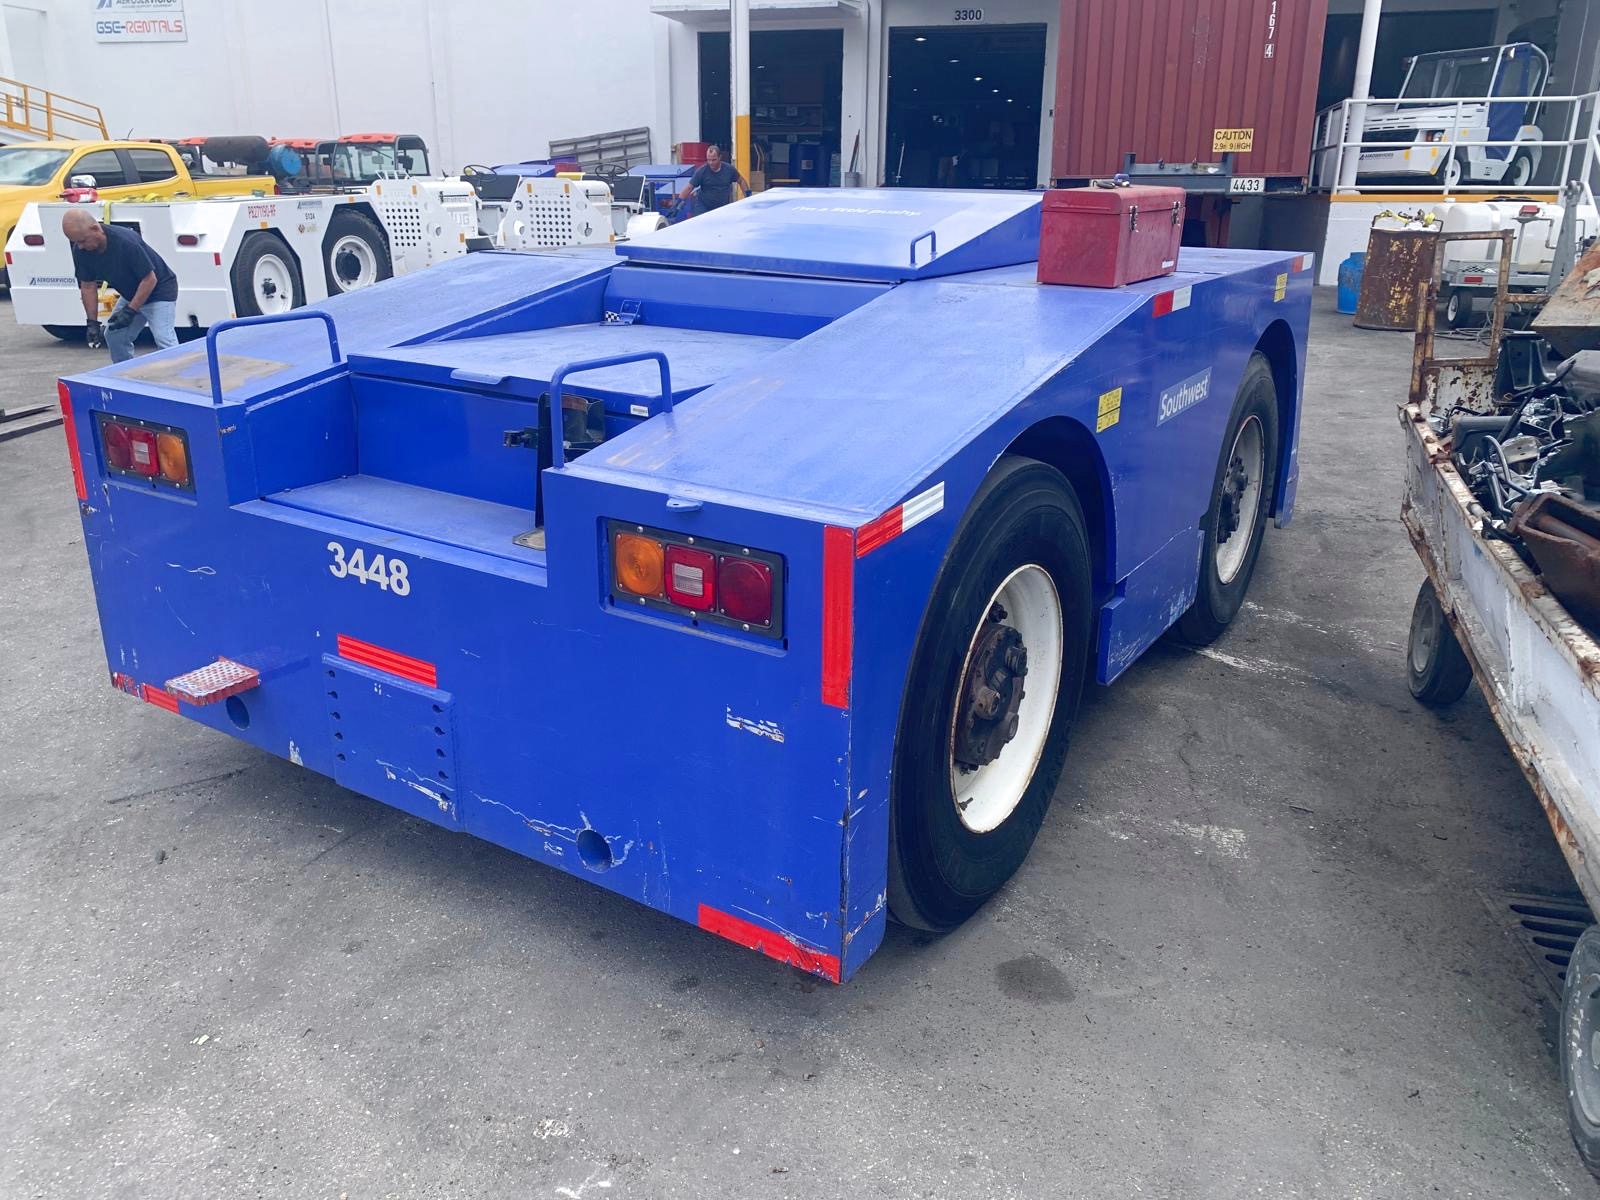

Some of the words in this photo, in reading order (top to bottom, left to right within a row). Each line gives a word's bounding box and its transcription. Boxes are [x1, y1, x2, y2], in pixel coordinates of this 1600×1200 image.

[954, 9, 982, 21] 3300
[96, 19, 183, 34] GSE-RENTALS
[1233, 179, 1260, 191] 4433
[1159, 375, 1209, 421] Southwest
[327, 541, 411, 597] 3448
